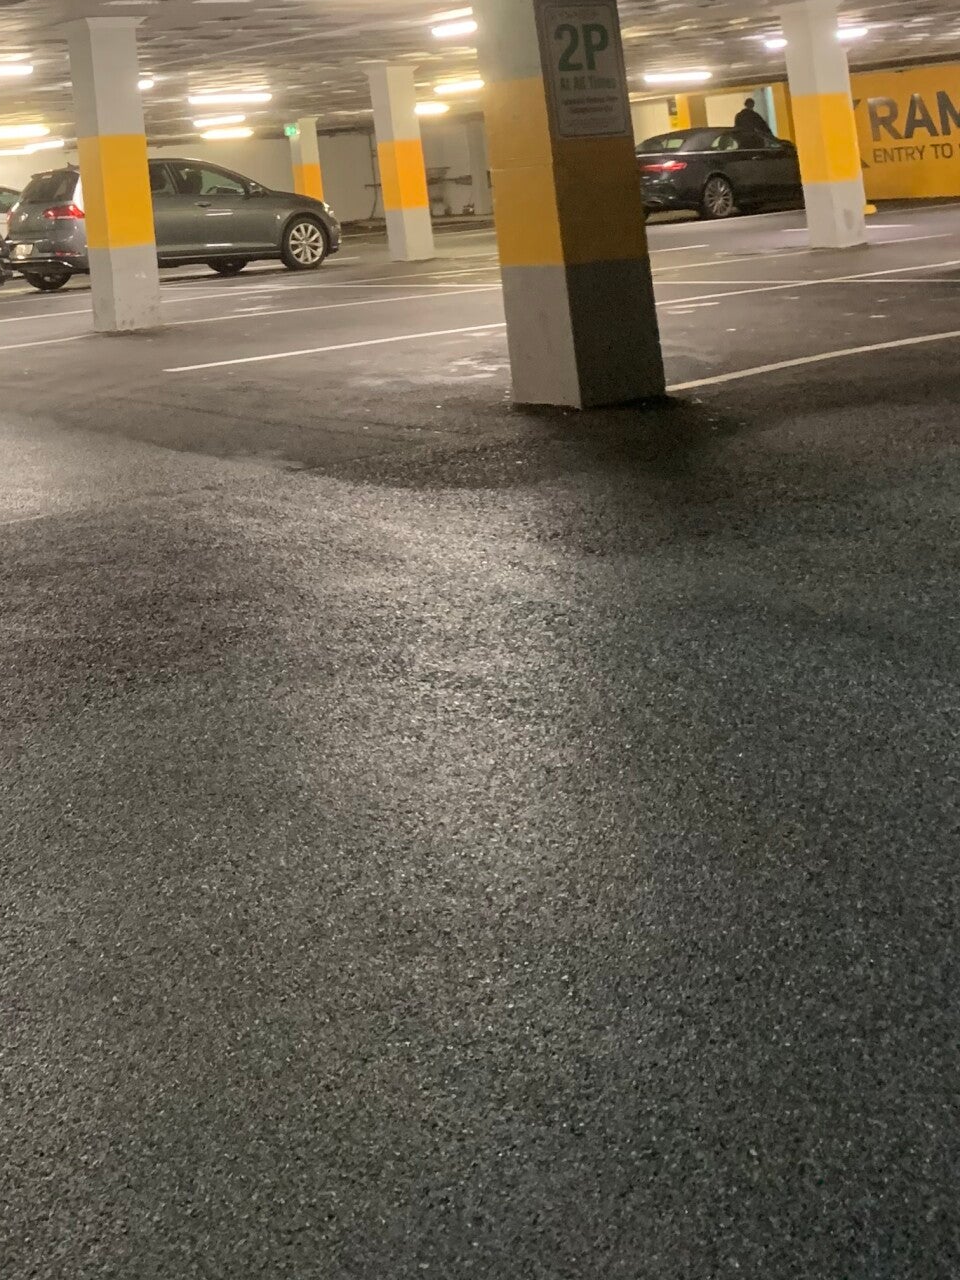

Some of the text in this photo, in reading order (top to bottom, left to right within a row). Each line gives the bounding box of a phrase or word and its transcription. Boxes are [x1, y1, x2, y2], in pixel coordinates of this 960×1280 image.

[554, 23, 609, 71] 2P
[872, 142, 953, 164] ENTRY TO
